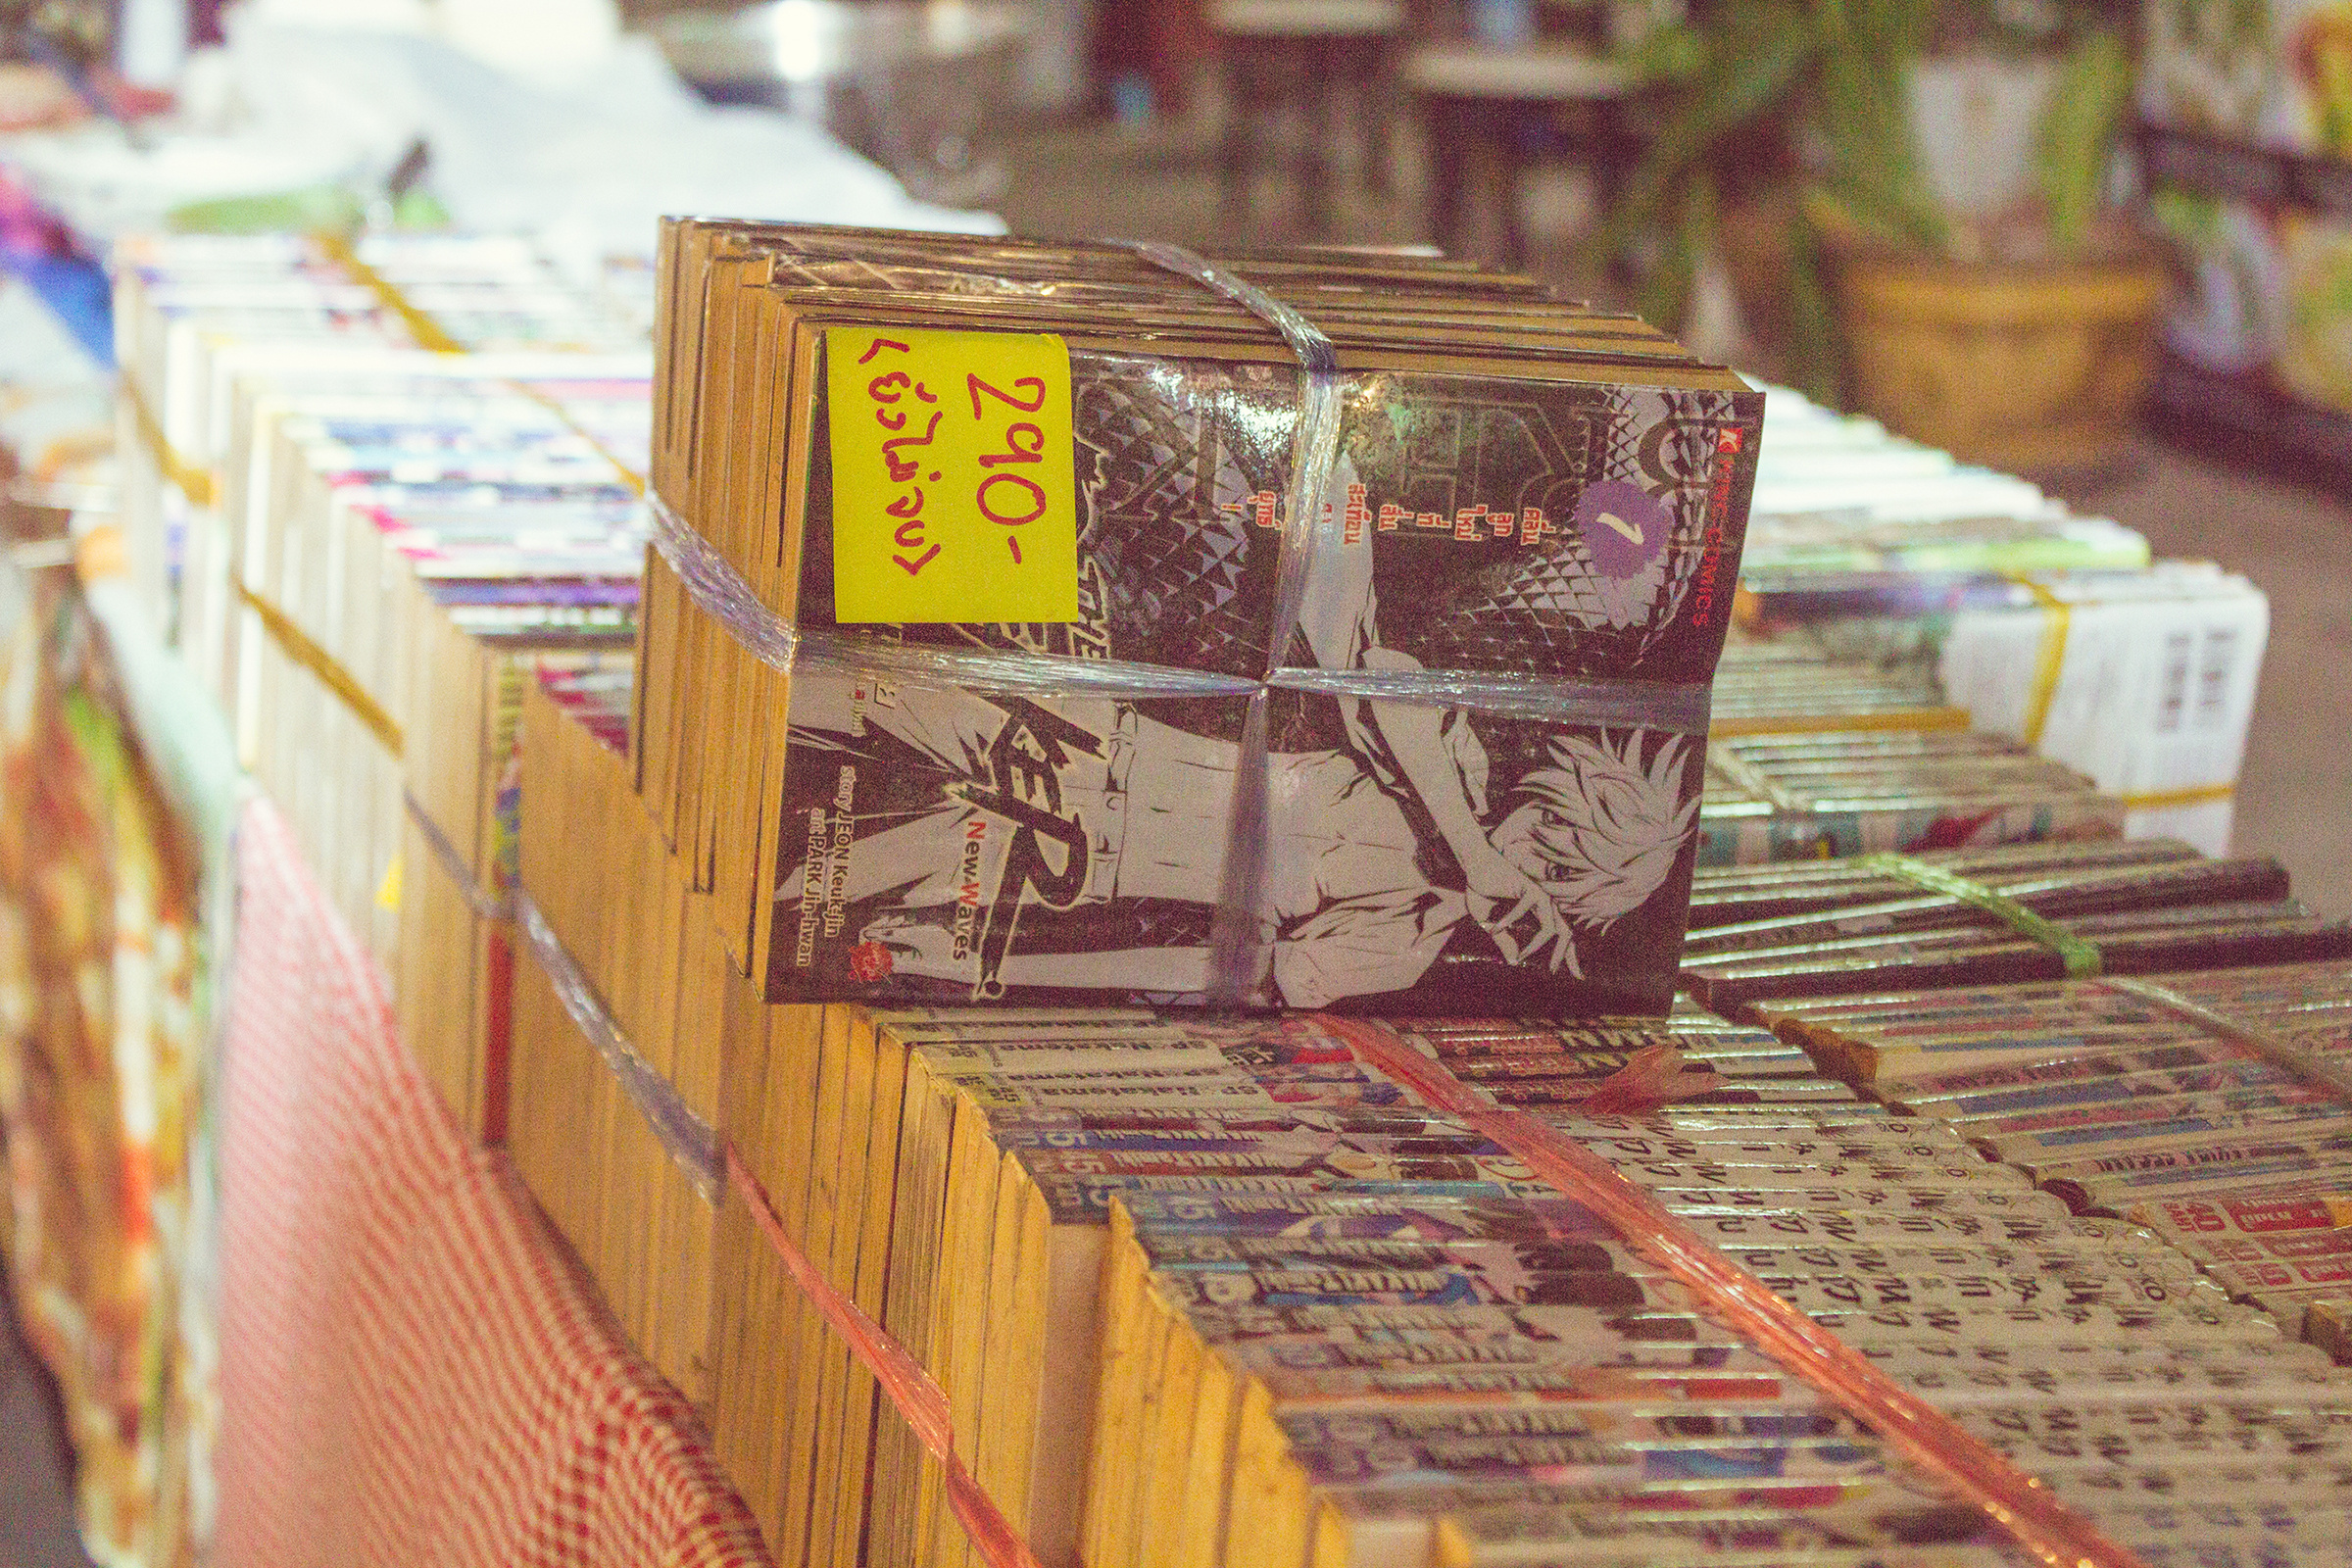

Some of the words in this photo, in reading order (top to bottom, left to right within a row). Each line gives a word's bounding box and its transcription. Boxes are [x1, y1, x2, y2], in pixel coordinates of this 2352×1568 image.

[1691, 527, 1723, 628] COMICS
[806, 836, 826, 885] PARK
[834, 812, 854, 861] JEON
[952, 881, 981, 961] Waves
